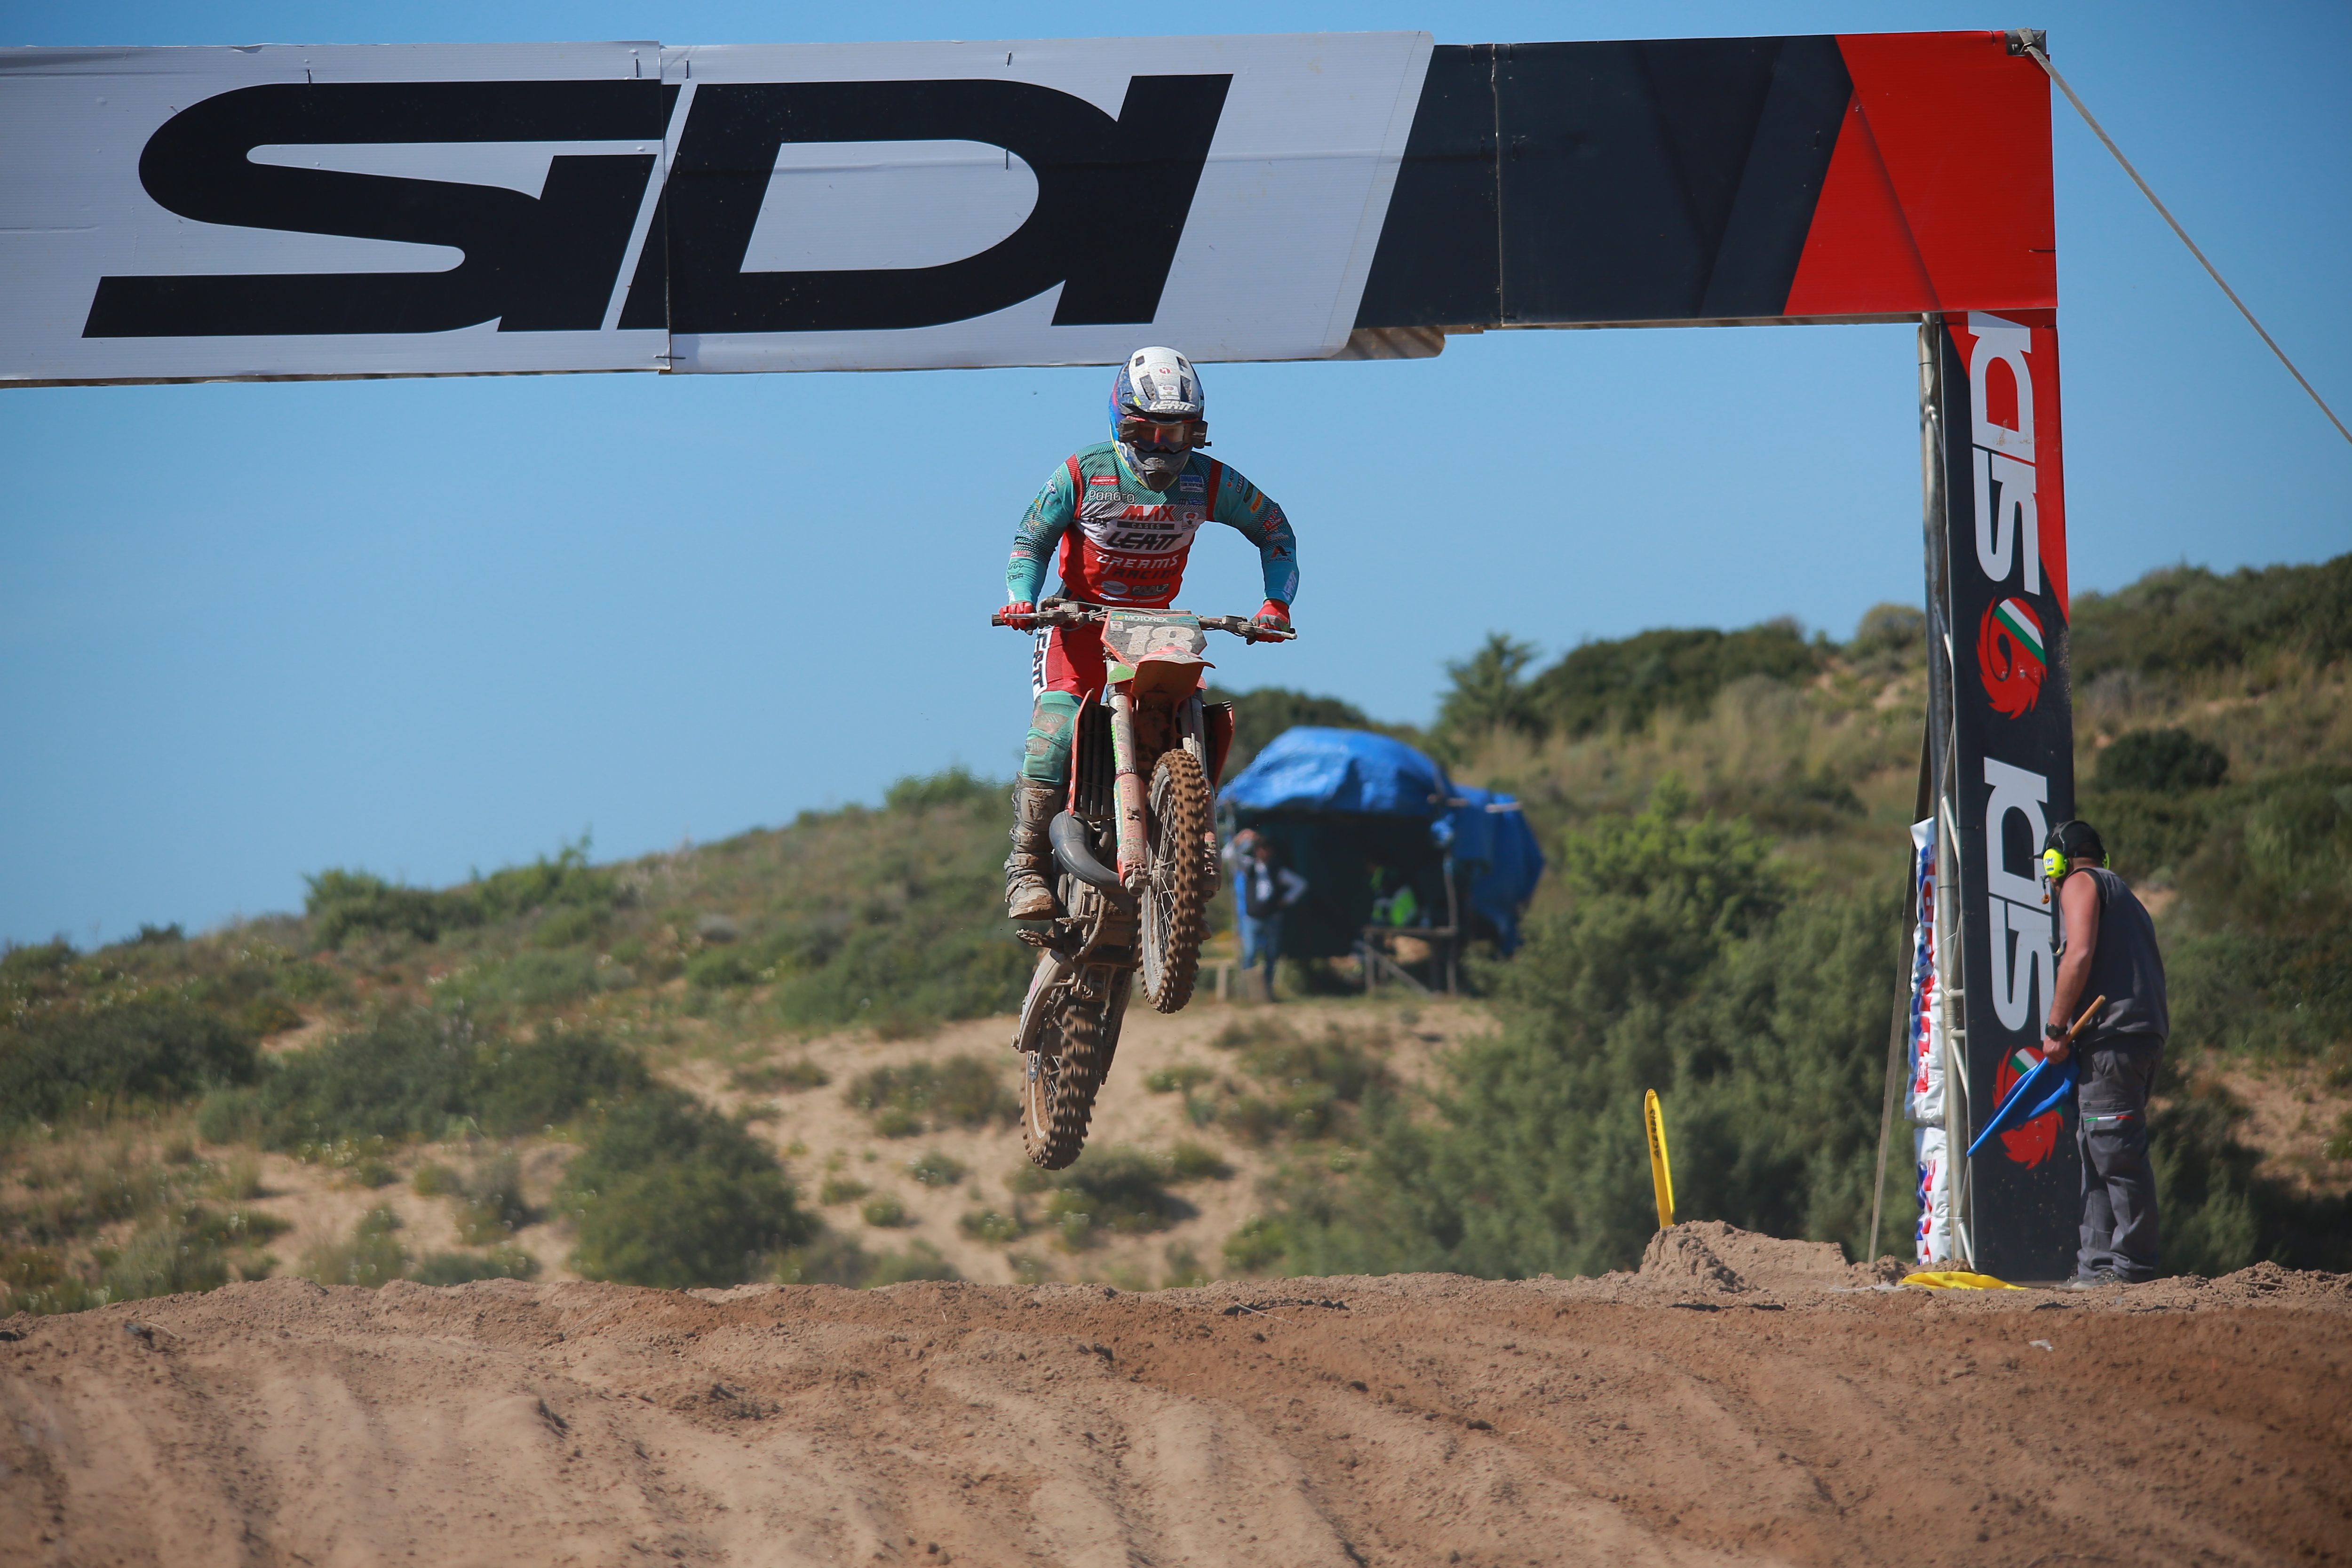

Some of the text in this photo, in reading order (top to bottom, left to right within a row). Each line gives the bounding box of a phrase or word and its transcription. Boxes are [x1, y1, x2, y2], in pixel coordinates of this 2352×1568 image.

[81, 74, 1233, 338] SIDI
[1149, 400, 1195, 411] LEATT
[1968, 311, 2040, 596] SIDI
[1119, 505, 1176, 522] MAX
[1106, 531, 1184, 551] LEATT
[1125, 625, 1195, 655] 18
[1984, 756, 2056, 1041] SIDI
